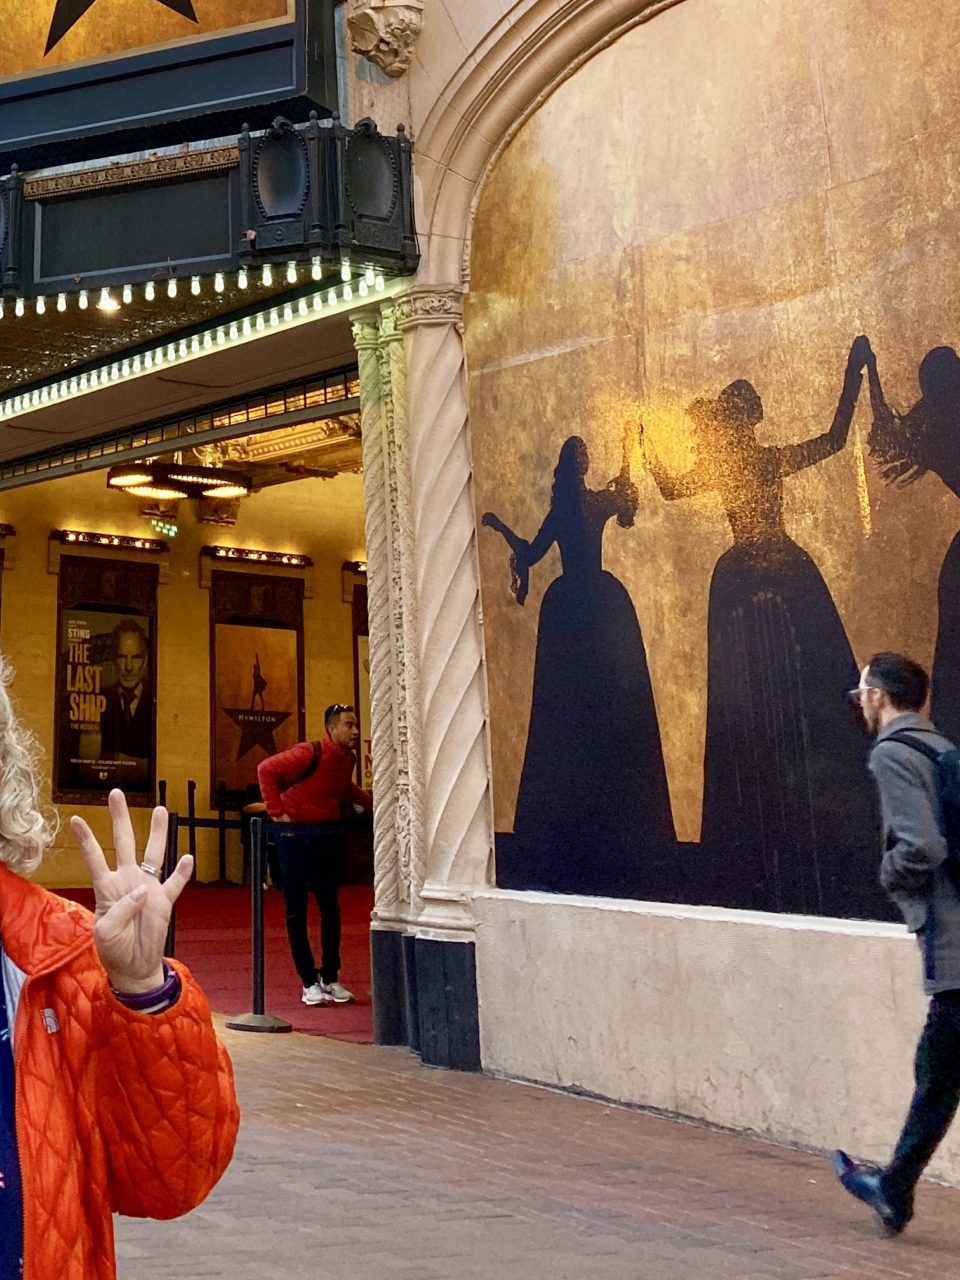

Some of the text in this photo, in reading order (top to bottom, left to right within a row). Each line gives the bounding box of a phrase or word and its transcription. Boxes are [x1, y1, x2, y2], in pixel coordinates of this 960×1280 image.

[68, 628, 90, 639] STING
[68, 642, 90, 664] THE
[67, 665, 102, 692] LAST
[69, 693, 107, 722] SHIP
[238, 714, 277, 722] HAMILTON
